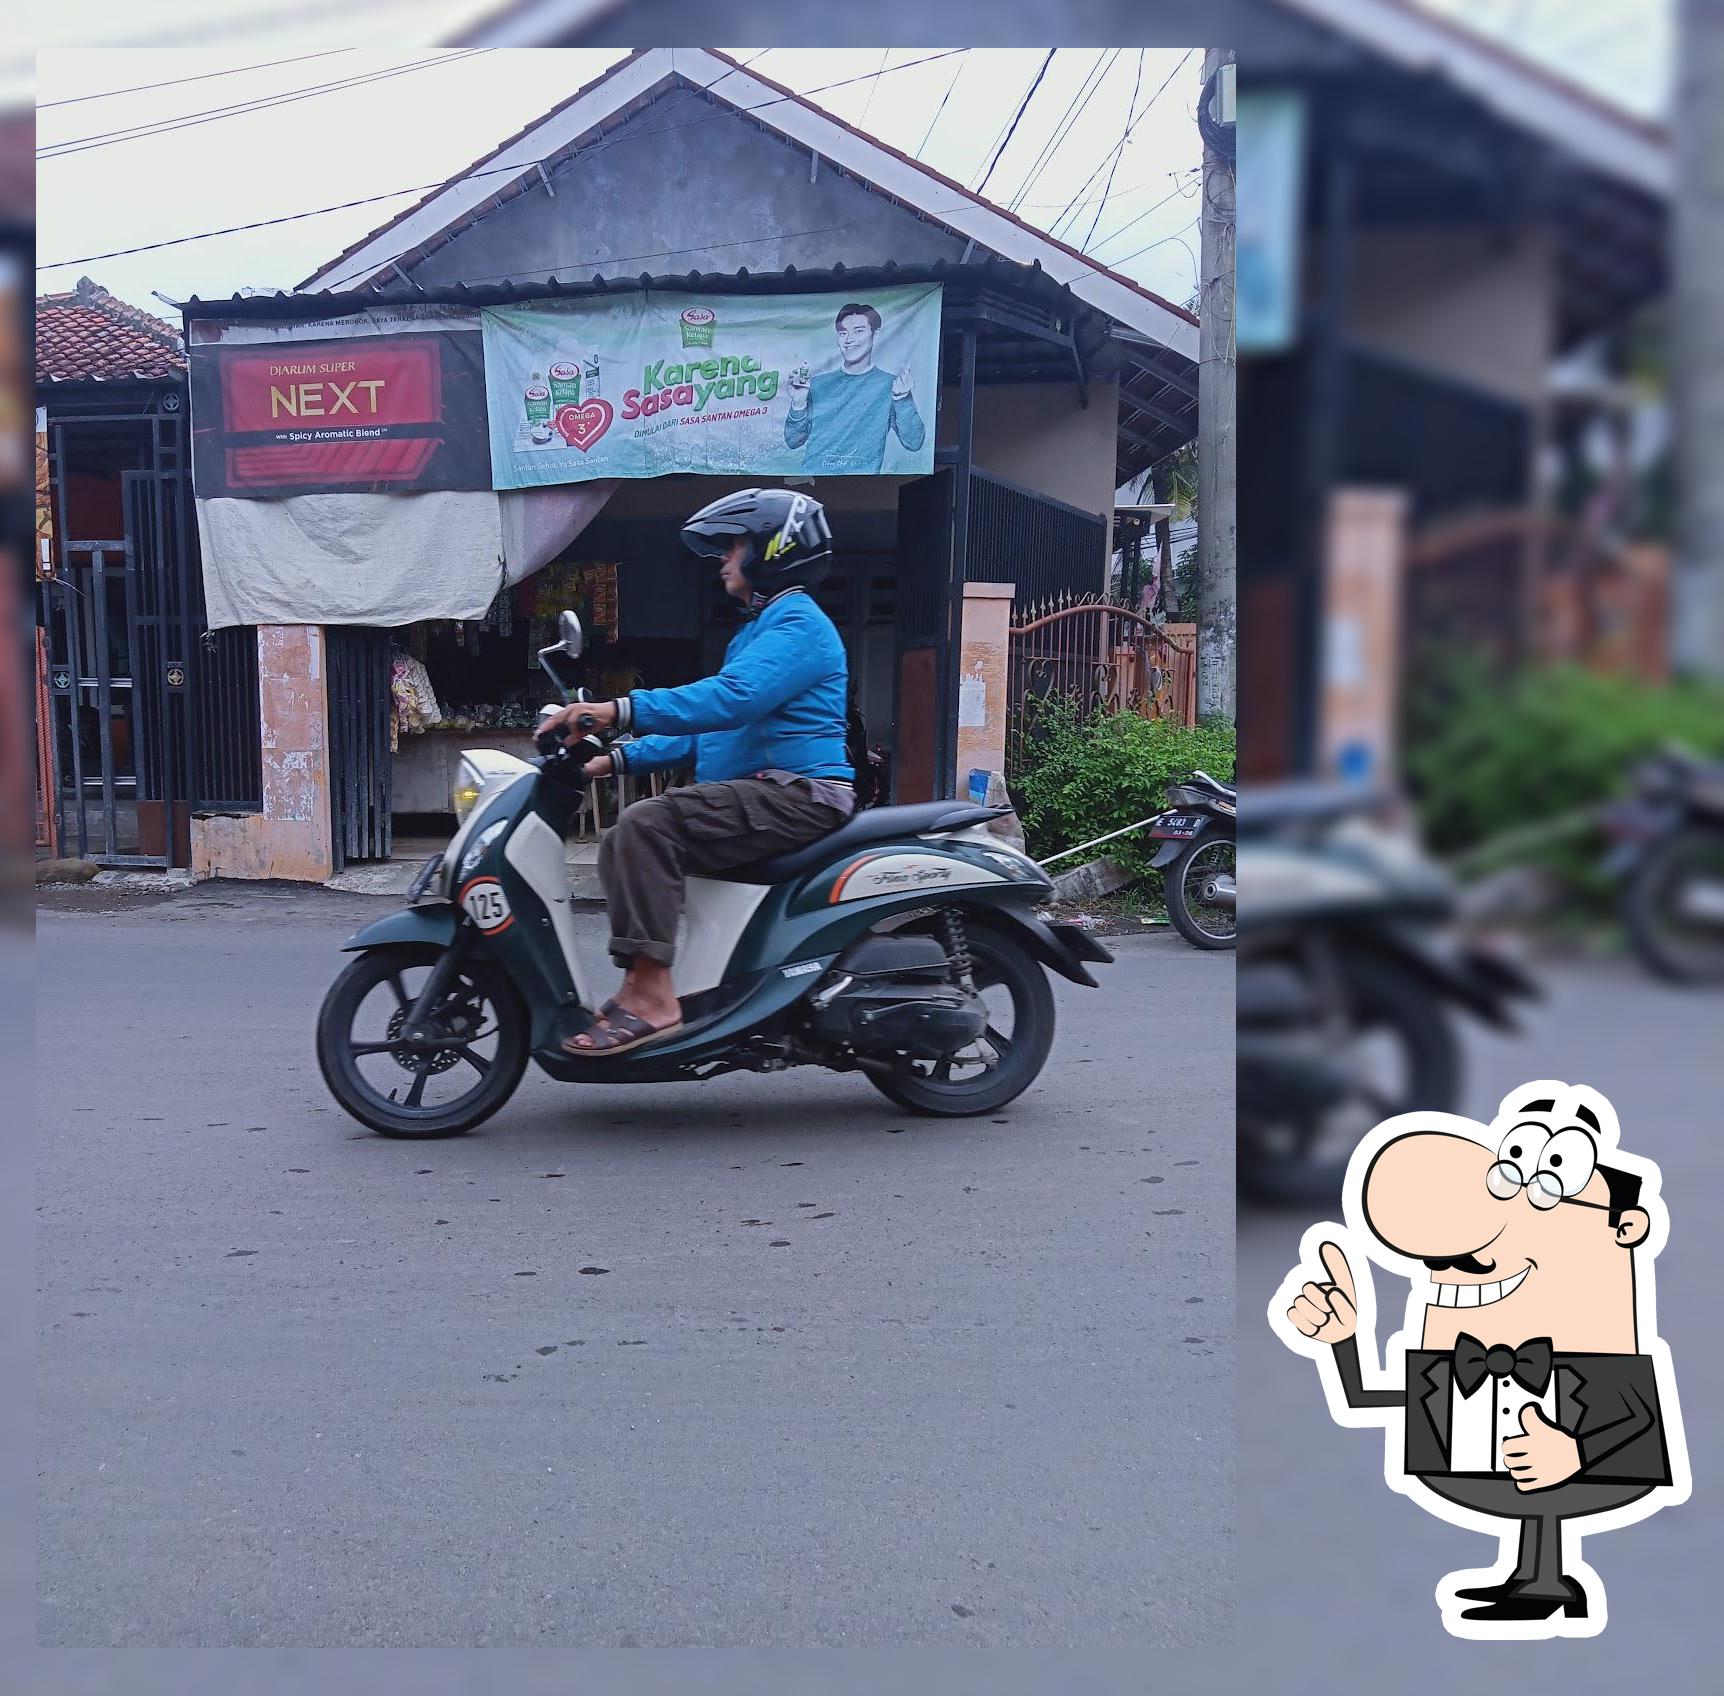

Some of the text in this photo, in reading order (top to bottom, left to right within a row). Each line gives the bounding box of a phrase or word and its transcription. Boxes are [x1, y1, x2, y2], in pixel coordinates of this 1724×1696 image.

[270, 361, 357, 376] DJARUM SUPER
[643, 354, 762, 395] Karena
[270, 380, 386, 418] NEXT
[620, 370, 779, 420] Sasayang
[569, 412, 596, 420] OMEGA
[578, 423, 586, 434] 3
[634, 406, 768, 438] DIMULAI DARI SASA SANTAN OMEGA 3
[289, 431, 312, 441] Spicy
[314, 429, 354, 439] Aromatic
[355, 427, 381, 437] Blend
[469, 891, 503, 920] 125
